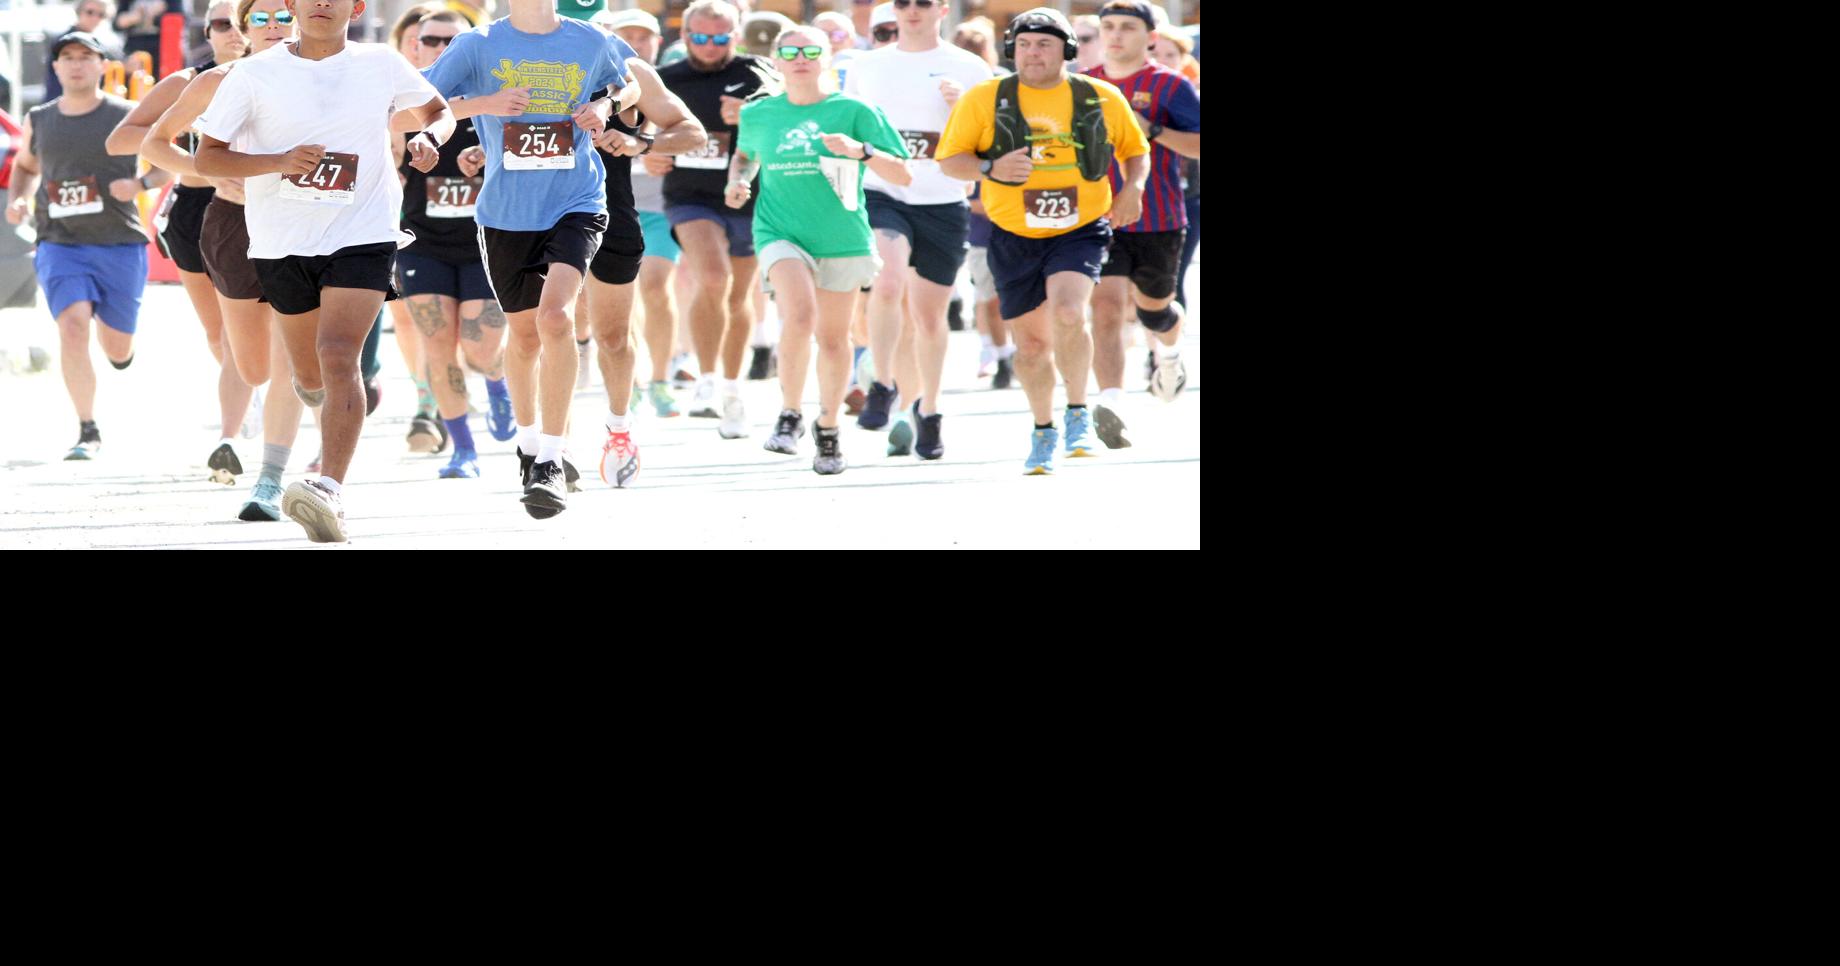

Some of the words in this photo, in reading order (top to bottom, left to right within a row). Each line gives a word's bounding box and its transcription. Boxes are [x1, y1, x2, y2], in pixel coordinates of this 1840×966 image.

[531, 90, 567, 100] ASSIC
[519, 133, 560, 155] 254
[906, 138, 928, 158] 52
[58, 185, 88, 206] 237
[438, 185, 472, 205] 217
[1035, 196, 1070, 217] 223
